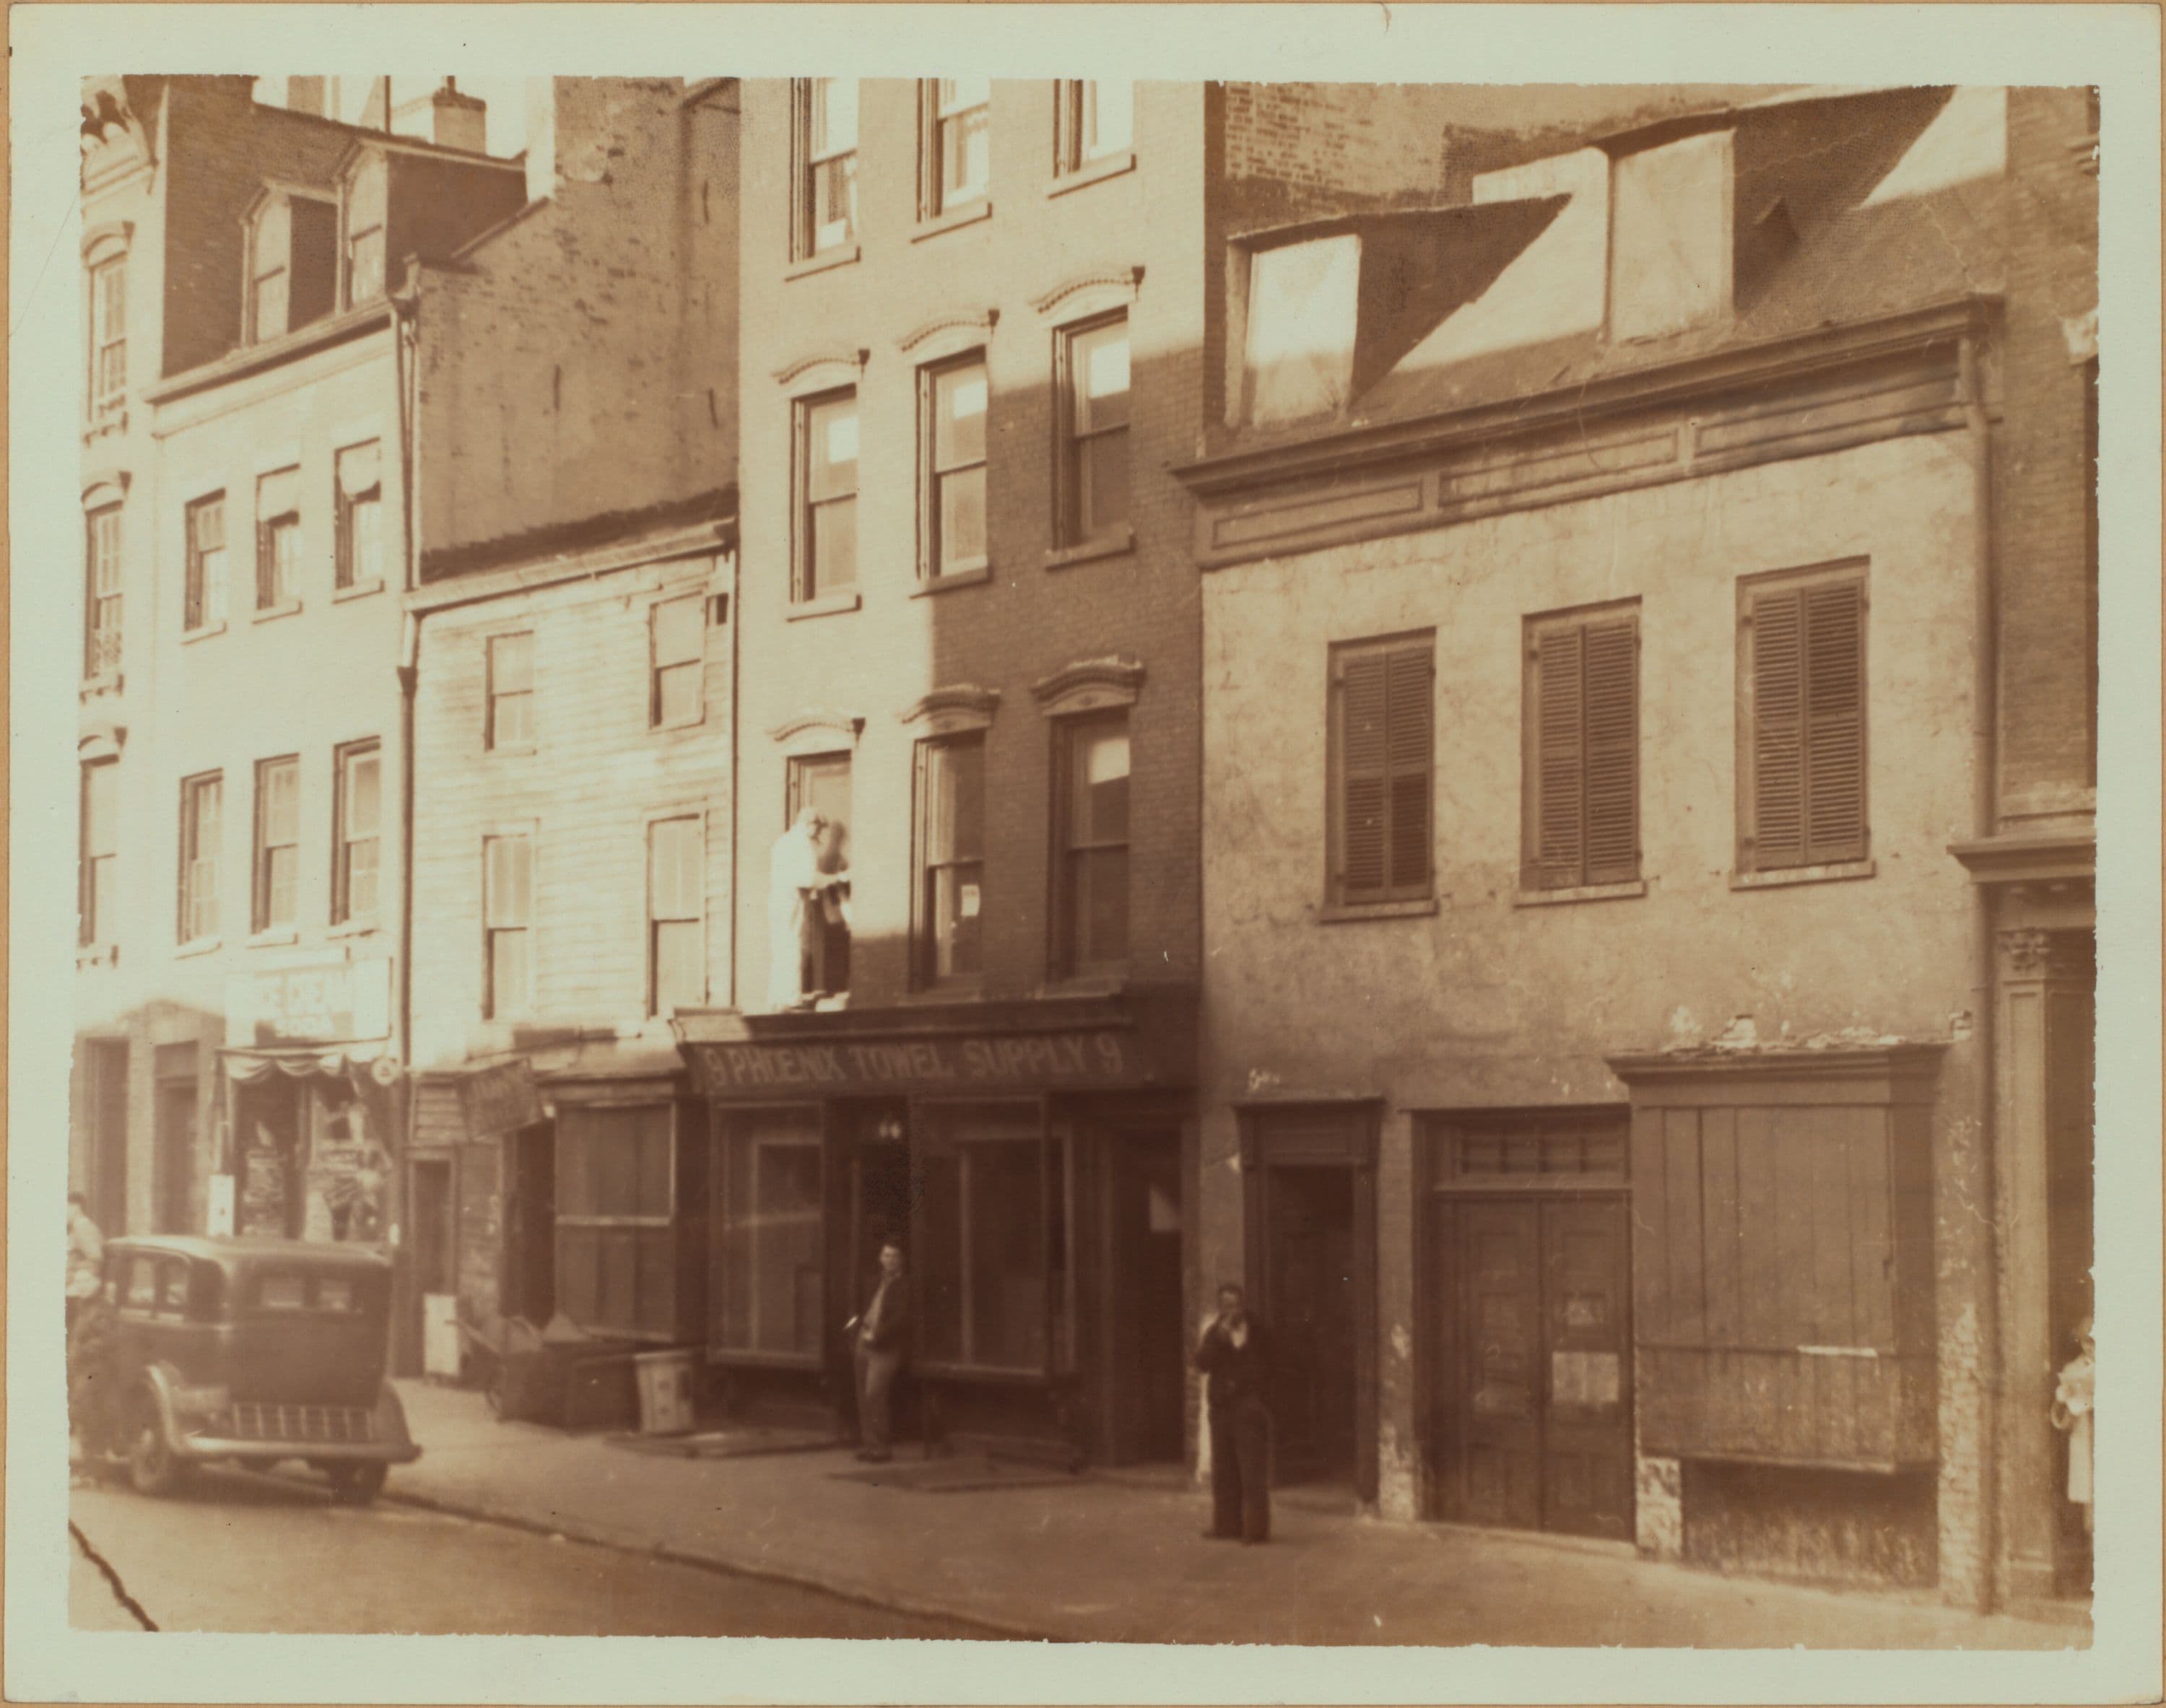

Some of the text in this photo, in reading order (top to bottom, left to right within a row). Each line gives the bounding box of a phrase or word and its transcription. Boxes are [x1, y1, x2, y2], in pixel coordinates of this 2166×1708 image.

[705, 1032, 1123, 1085] 9 PHOENIX TOWEL SUPPLY 9
